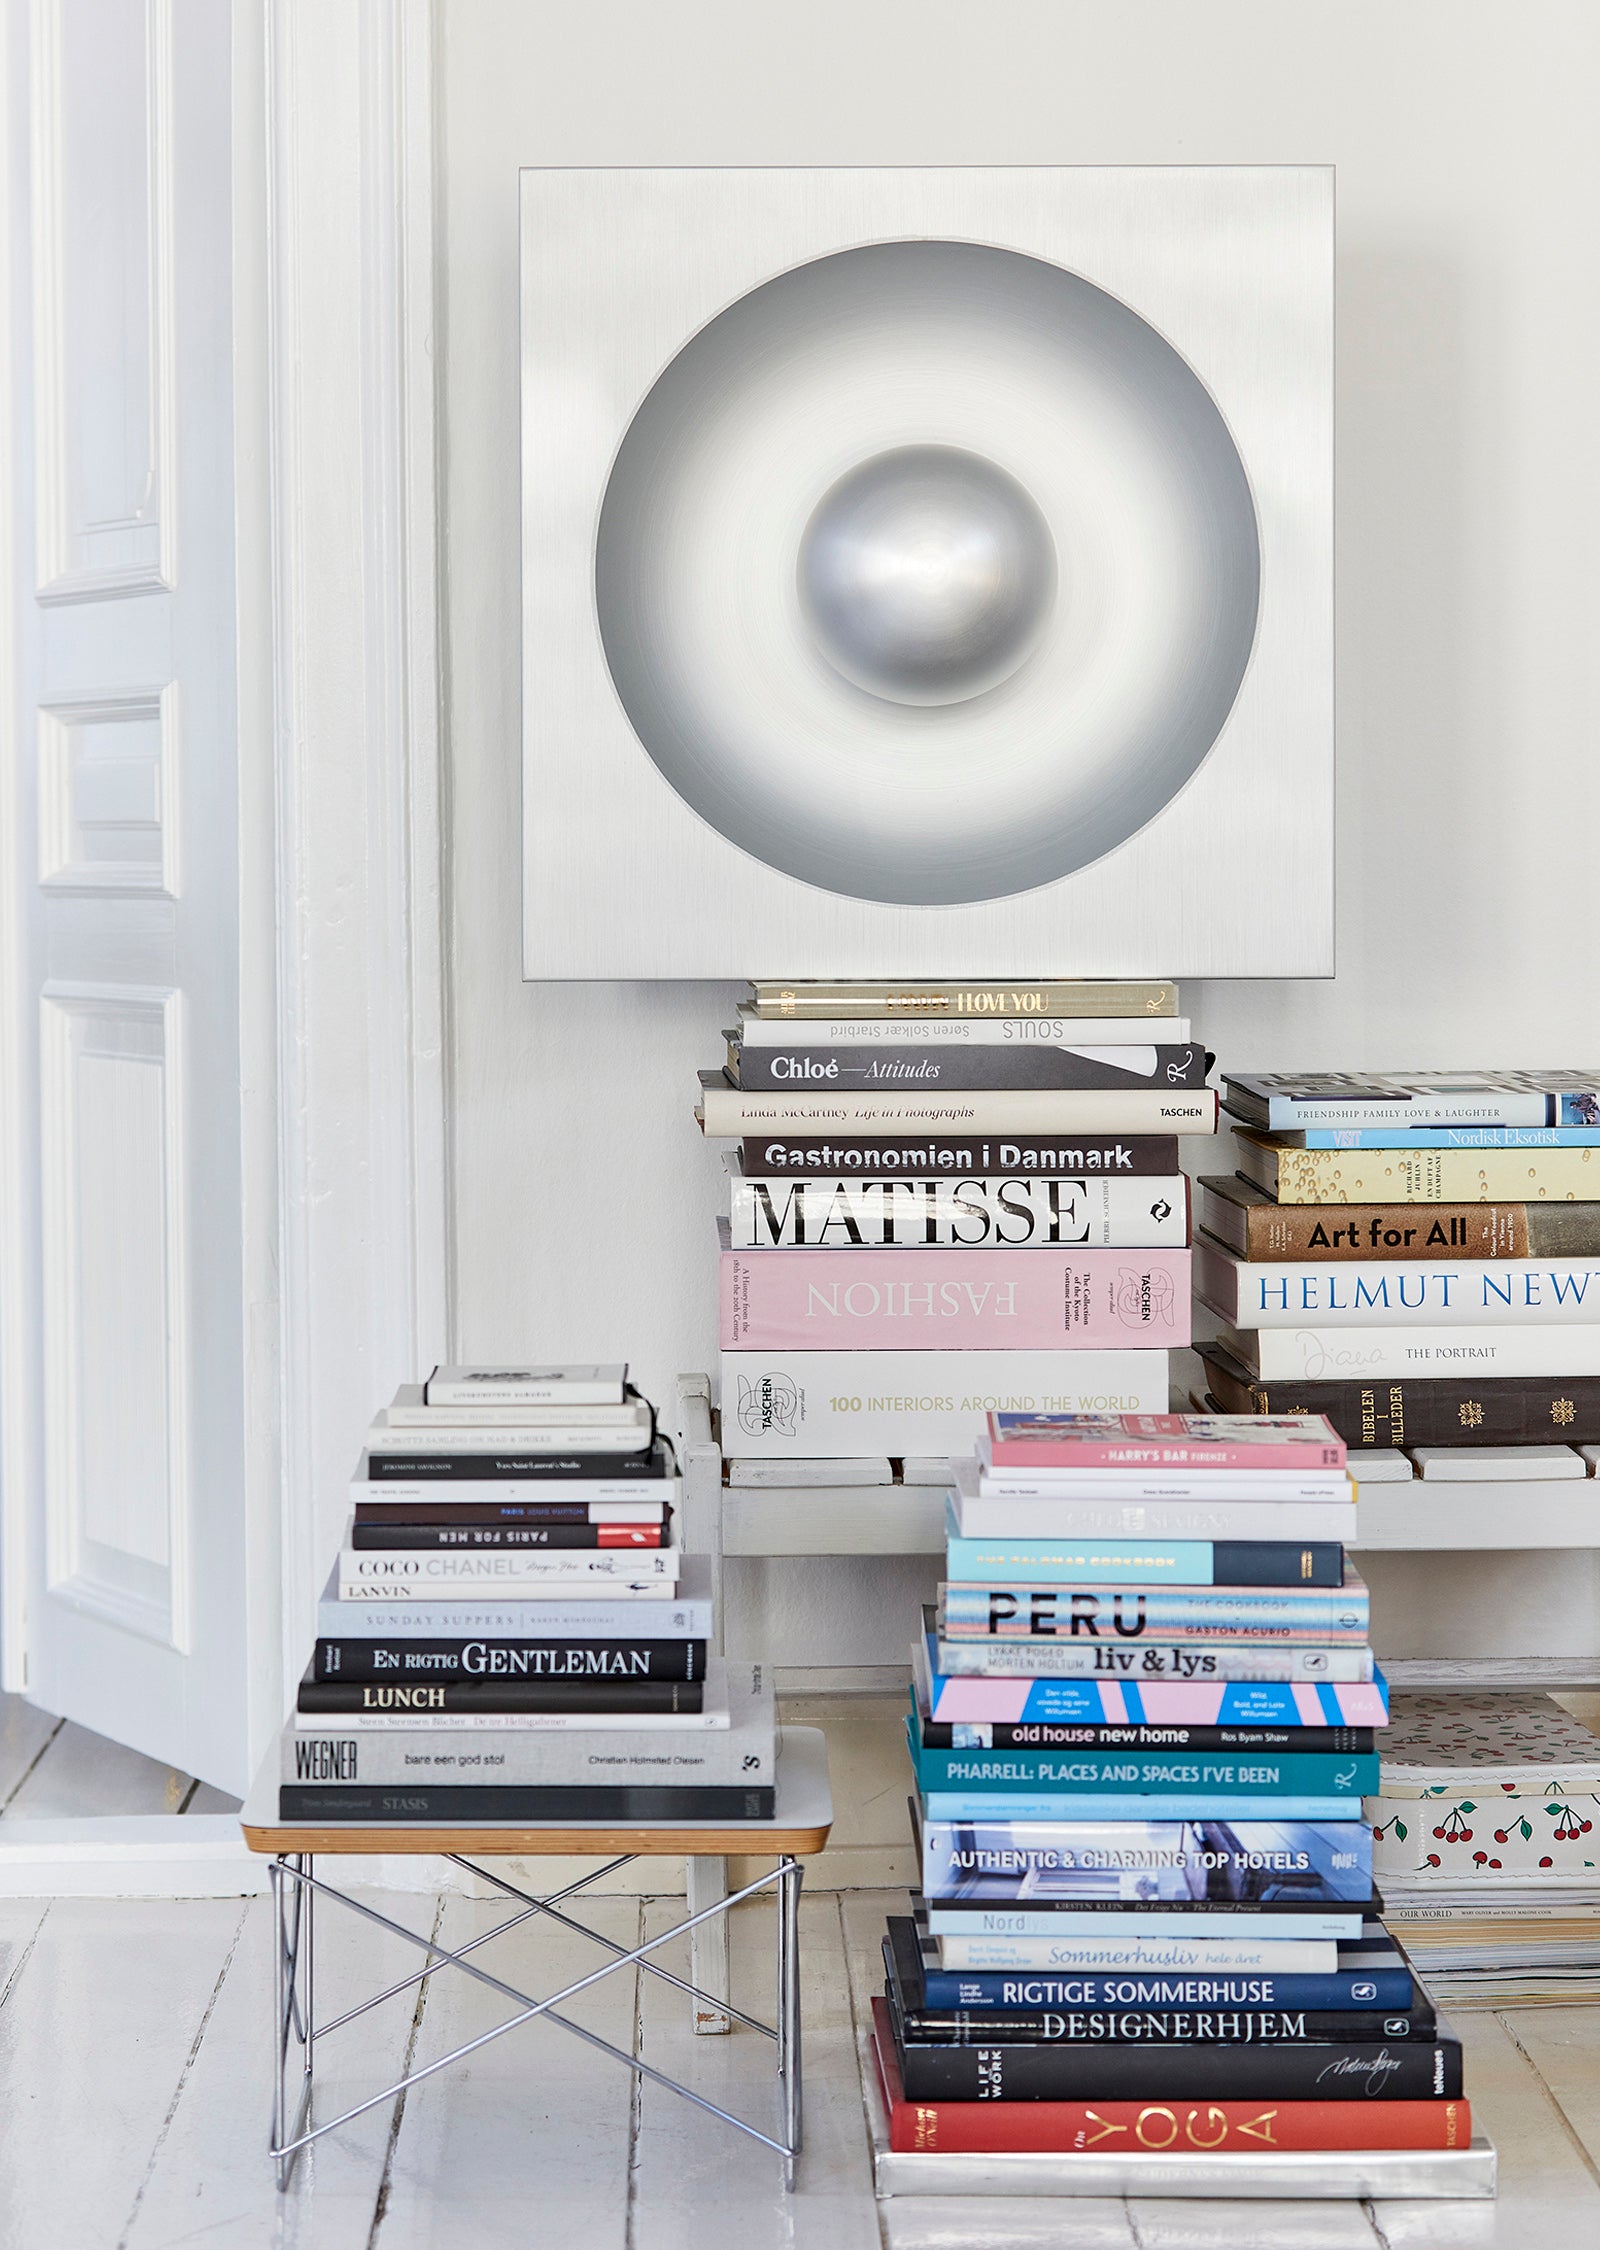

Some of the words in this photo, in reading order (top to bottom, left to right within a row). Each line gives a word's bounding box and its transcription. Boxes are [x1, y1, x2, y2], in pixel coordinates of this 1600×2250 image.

[1011, 992, 1049, 1012] YOU
[830, 1026, 881, 1038] Starbird
[884, 1025, 930, 1038] Solkær
[932, 1025, 970, 1038] Søren
[1001, 1020, 1064, 1039] SOULS
[854, 1105, 880, 1120] Life
[882, 1105, 893, 1118] in
[896, 1105, 975, 1120] Photographs
[1159, 1108, 1203, 1117] TASCHEN
[1297, 1110, 1360, 1119] FRIENDSHIP
[1363, 1110, 1401, 1118] FAMILY
[1404, 1109, 1431, 1118] LOVE
[1434, 1109, 1441, 1117] &
[1445, 1109, 1501, 1118] LAUGHTER
[1333, 1130, 1362, 1147] VISIT
[1447, 1129, 1501, 1145] Nordisk
[1504, 1128, 1560, 1145] Eksotisk
[764, 1143, 973, 1169] Gastronomien
[982, 1144, 989, 1168] i
[1000, 1143, 1133, 1169] Danmark
[745, 1179, 1091, 1246] MATISSE
[1307, 1221, 1360, 1248] Art
[1369, 1218, 1417, 1247] for
[1425, 1217, 1467, 1246] All
[741, 1276, 750, 1302] History
[1064, 1267, 1072, 1299] Costume
[1073, 1276, 1081, 1284] of
[1083, 1272, 1091, 1287] The
[732, 1284, 740, 1295] the
[804, 1281, 1019, 1317] FASHION
[1141, 1273, 1150, 1321] TASCHEN
[1258, 1274, 1459, 1311] HELMUT
[1480, 1271, 1600, 1307] NEW
[742, 1304, 750, 1320] from
[1064, 1301, 1072, 1331] Institute
[1072, 1297, 1081, 1322] Kyoto
[1083, 1289, 1091, 1326] Collection
[732, 1314, 740, 1342] Century
[742, 1322, 750, 1333] the
[1404, 1347, 1431, 1359] THE
[1435, 1346, 1497, 1359] PORTRAIT
[762, 1378, 772, 1430] TASCHEN
[829, 1396, 862, 1412] 100
[867, 1396, 954, 1412] INTERIORS
[960, 1396, 1035, 1411] AROUND
[1042, 1396, 1072, 1411] THE
[1078, 1396, 1140, 1411] WORLD
[1361, 1389, 1376, 1444] BIBELEN
[1389, 1385, 1403, 1446] BILLEDER
[1108, 1449, 1160, 1462] HARRY'S
[1163, 1450, 1188, 1462] BAR
[1190, 1452, 1227, 1462] FIRENZE
[438, 1531, 469, 1543] MEN
[474, 1531, 502, 1543] FOR
[507, 1531, 548, 1543] PARIS
[359, 1560, 420, 1577] COCO
[426, 1558, 521, 1577] CHANEL
[1089, 1556, 1177, 1568] COOKBOOK
[348, 1586, 411, 1598] LANVIN
[366, 1615, 433, 1626] SUNDAY
[442, 1615, 514, 1626] SUPPERS
[989, 1592, 1147, 1638] PERU
[1185, 1624, 1238, 1637] GASTON
[1243, 1625, 1291, 1638] ACURIO
[988, 1657, 1035, 1669] MORTEN
[1094, 1647, 1137, 1671] liv
[1141, 1650, 1165, 1672] &
[1172, 1648, 1217, 1678] lys
[362, 1687, 446, 1708] LUNCH
[1012, 1726, 1039, 1742] old
[1043, 1726, 1095, 1743] house
[1099, 1729, 1137, 1742] new
[1140, 1728, 1190, 1744] home
[1220, 1731, 1237, 1742] Ros
[1238, 1731, 1263, 1744] Byam
[1264, 1732, 1289, 1743] Shaw
[295, 1740, 358, 1780] WEGNER
[404, 1754, 431, 1765] bare
[434, 1755, 456, 1765] een
[458, 1754, 481, 1767] god
[483, 1754, 505, 1765] stol
[588, 1755, 628, 1765] Christian
[947, 1762, 1034, 1780] PHARRELL:
[1038, 1764, 1099, 1781] PLACES
[1101, 1765, 1139, 1781] AND
[1142, 1765, 1199, 1782] SPACES
[1203, 1766, 1235, 1783] I'VE
[1238, 1767, 1280, 1784] BEEN
[383, 1797, 429, 1812] STASIS
[948, 1850, 1058, 1868] AUTHENTIC
[1062, 1851, 1075, 1868] &
[1080, 1851, 1187, 1869] CHARMING
[1192, 1851, 1229, 1869] TOP
[1234, 1851, 1310, 1870] HOTELS
[1399, 1909, 1420, 1919] OUR
[1421, 1909, 1453, 1919] WORLD
[1048, 1945, 1200, 1966] Sommerhusliv
[1205, 1951, 1232, 1965] hele
[1235, 1951, 1263, 1965] året
[959, 1983, 981, 1992] Lange
[1003, 1981, 1096, 2003] RIGTIGE
[1103, 1980, 1275, 2003] SOMMERHUSE
[1042, 2012, 1308, 2044] DESIGNERHJEM
[978, 2050, 989, 2098] LIFE
[991, 2050, 1003, 2098] WORK
[1433, 2049, 1444, 2095] teNeues
[1085, 2105, 1278, 2150] YOGA
[1446, 2103, 1457, 2147] TASCHEN
[1074, 2130, 1086, 2149] On
